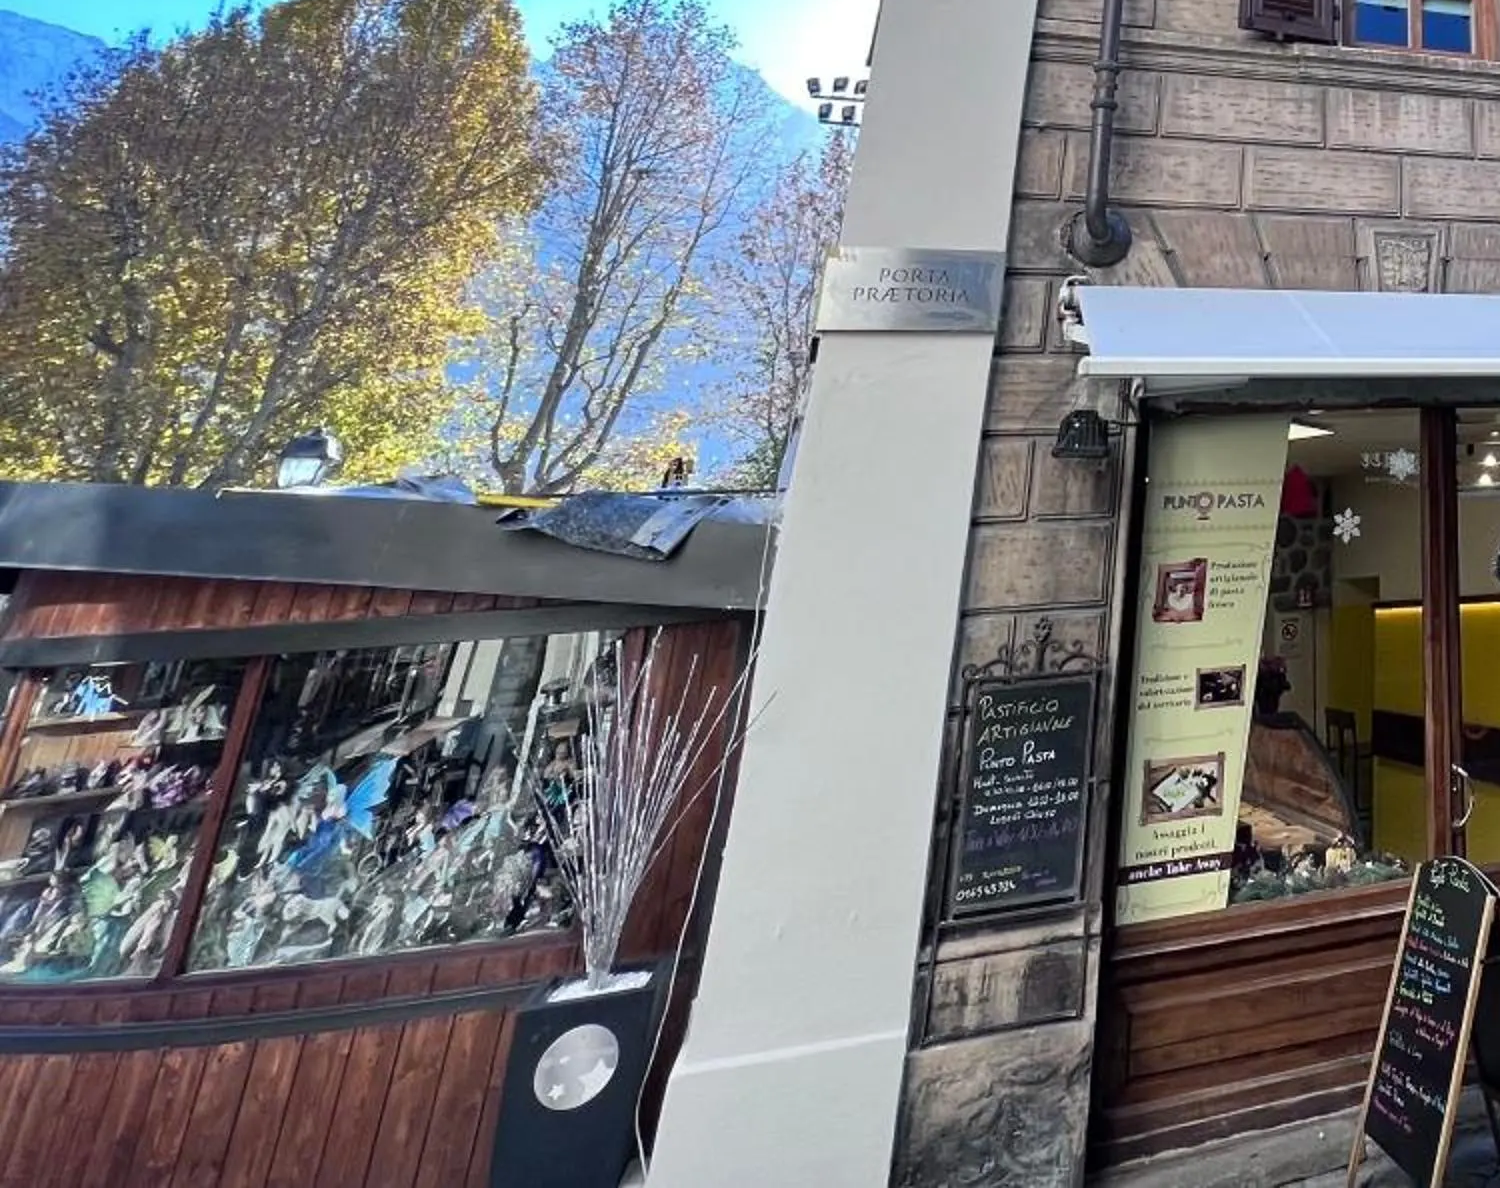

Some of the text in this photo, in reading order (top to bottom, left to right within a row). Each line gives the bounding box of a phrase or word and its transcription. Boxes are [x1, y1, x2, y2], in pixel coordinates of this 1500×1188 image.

[879, 267, 950, 283] PORTA
[852, 286, 970, 303] PRÆTORIA
[1163, 492, 1265, 511] PUNTO PASTA
[1128, 865, 1163, 881] anche
[1166, 861, 1192, 876] Take
